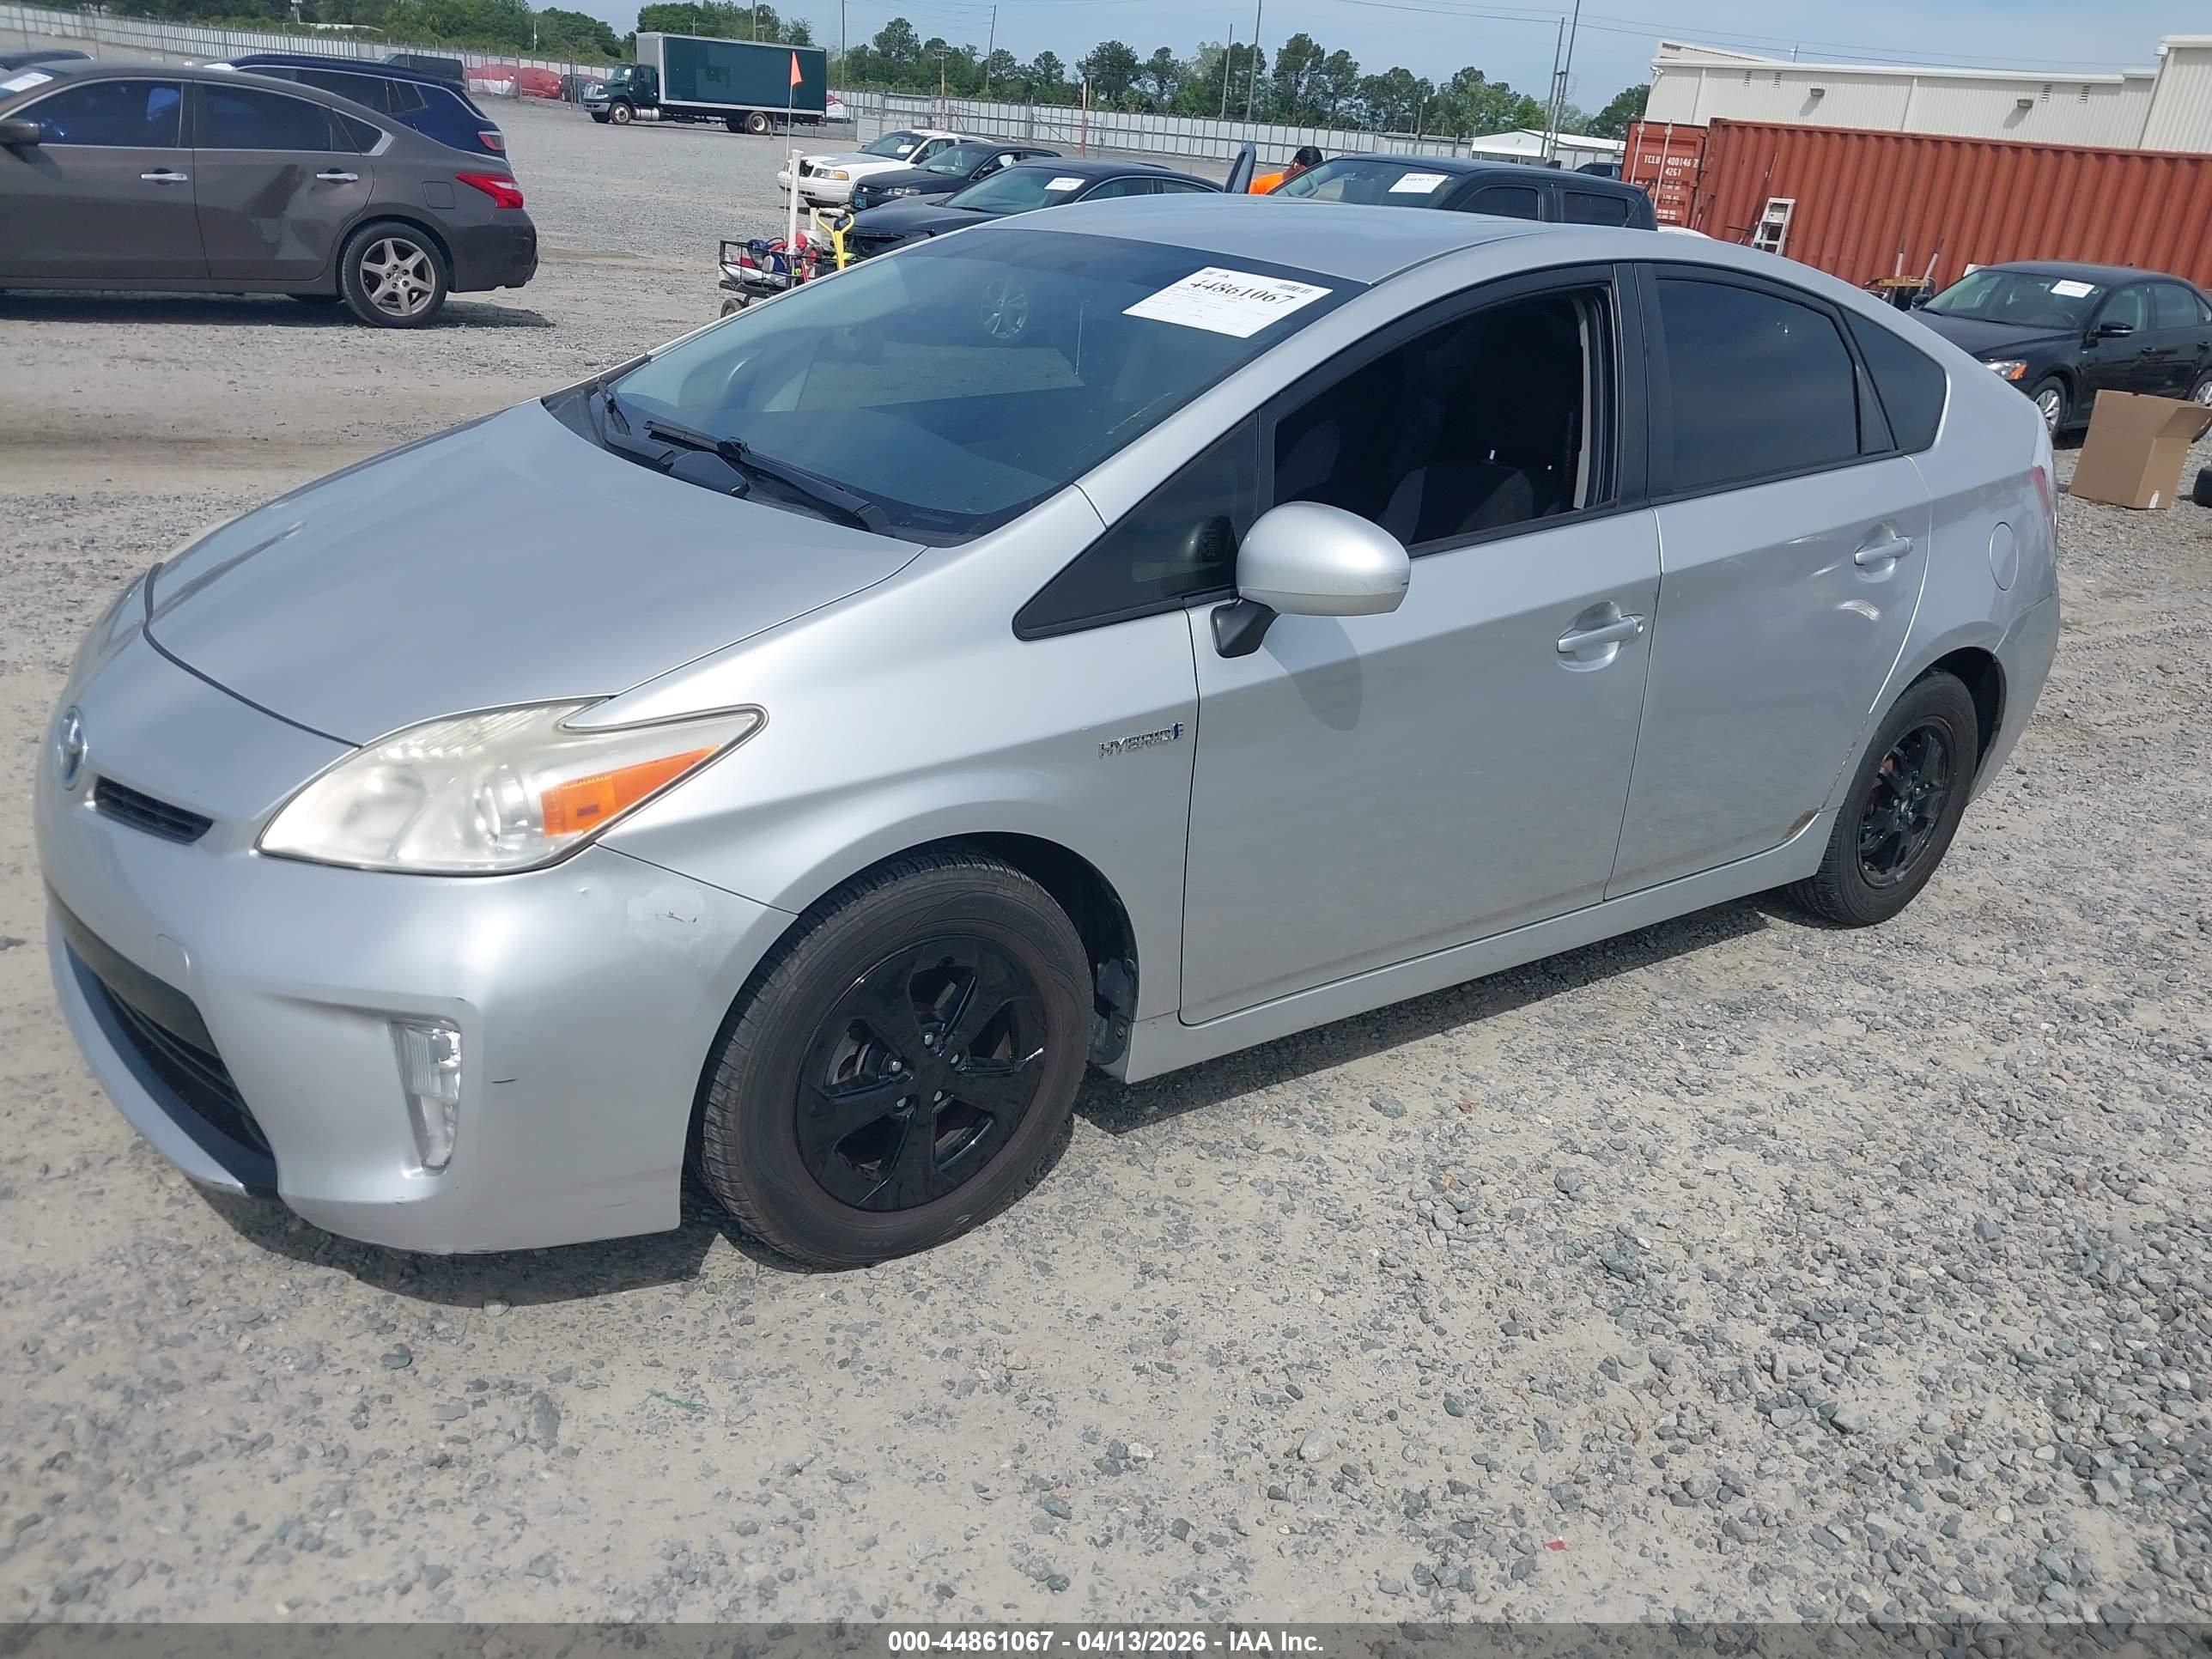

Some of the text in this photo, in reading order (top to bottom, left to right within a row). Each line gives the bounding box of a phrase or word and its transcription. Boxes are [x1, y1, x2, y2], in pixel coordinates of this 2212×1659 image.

[1644, 155, 1662, 164] TCLU
[1667, 156, 1692, 167] 400146
[1189, 279, 1297, 304] 44861067
[1099, 728, 1170, 757] HYBRID
